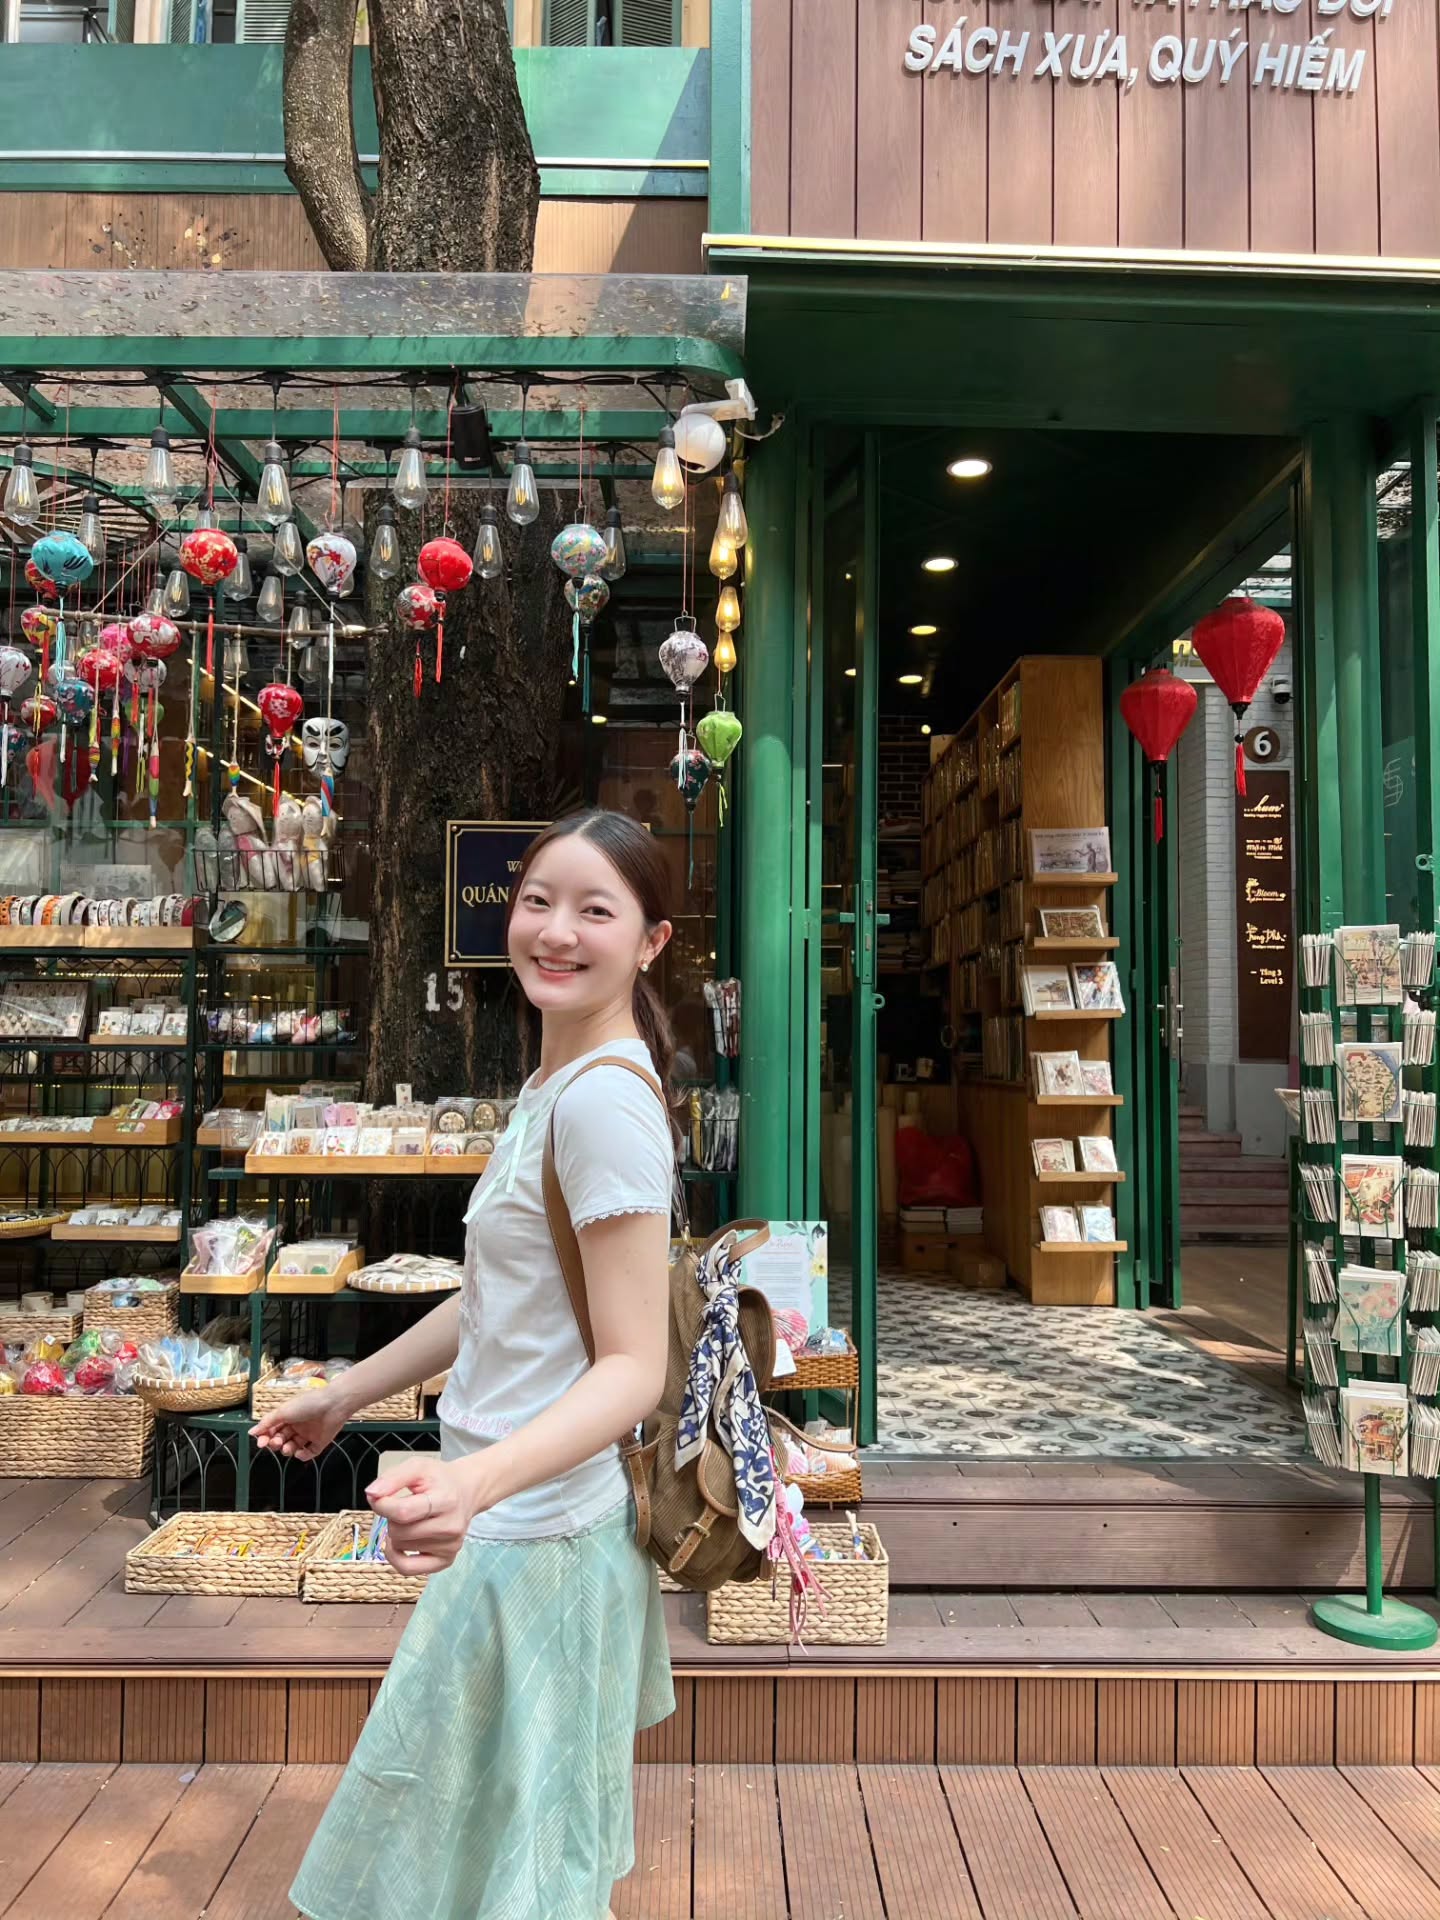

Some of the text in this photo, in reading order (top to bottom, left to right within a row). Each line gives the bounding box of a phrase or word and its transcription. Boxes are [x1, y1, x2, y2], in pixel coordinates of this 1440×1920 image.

[904, 16, 1366, 92] SÁCH XƯA, QUÝ HIẾM
[1254, 731, 1272, 756] 6
[462, 883, 509, 907] QUÁN
[423, 970, 465, 1013] 15
